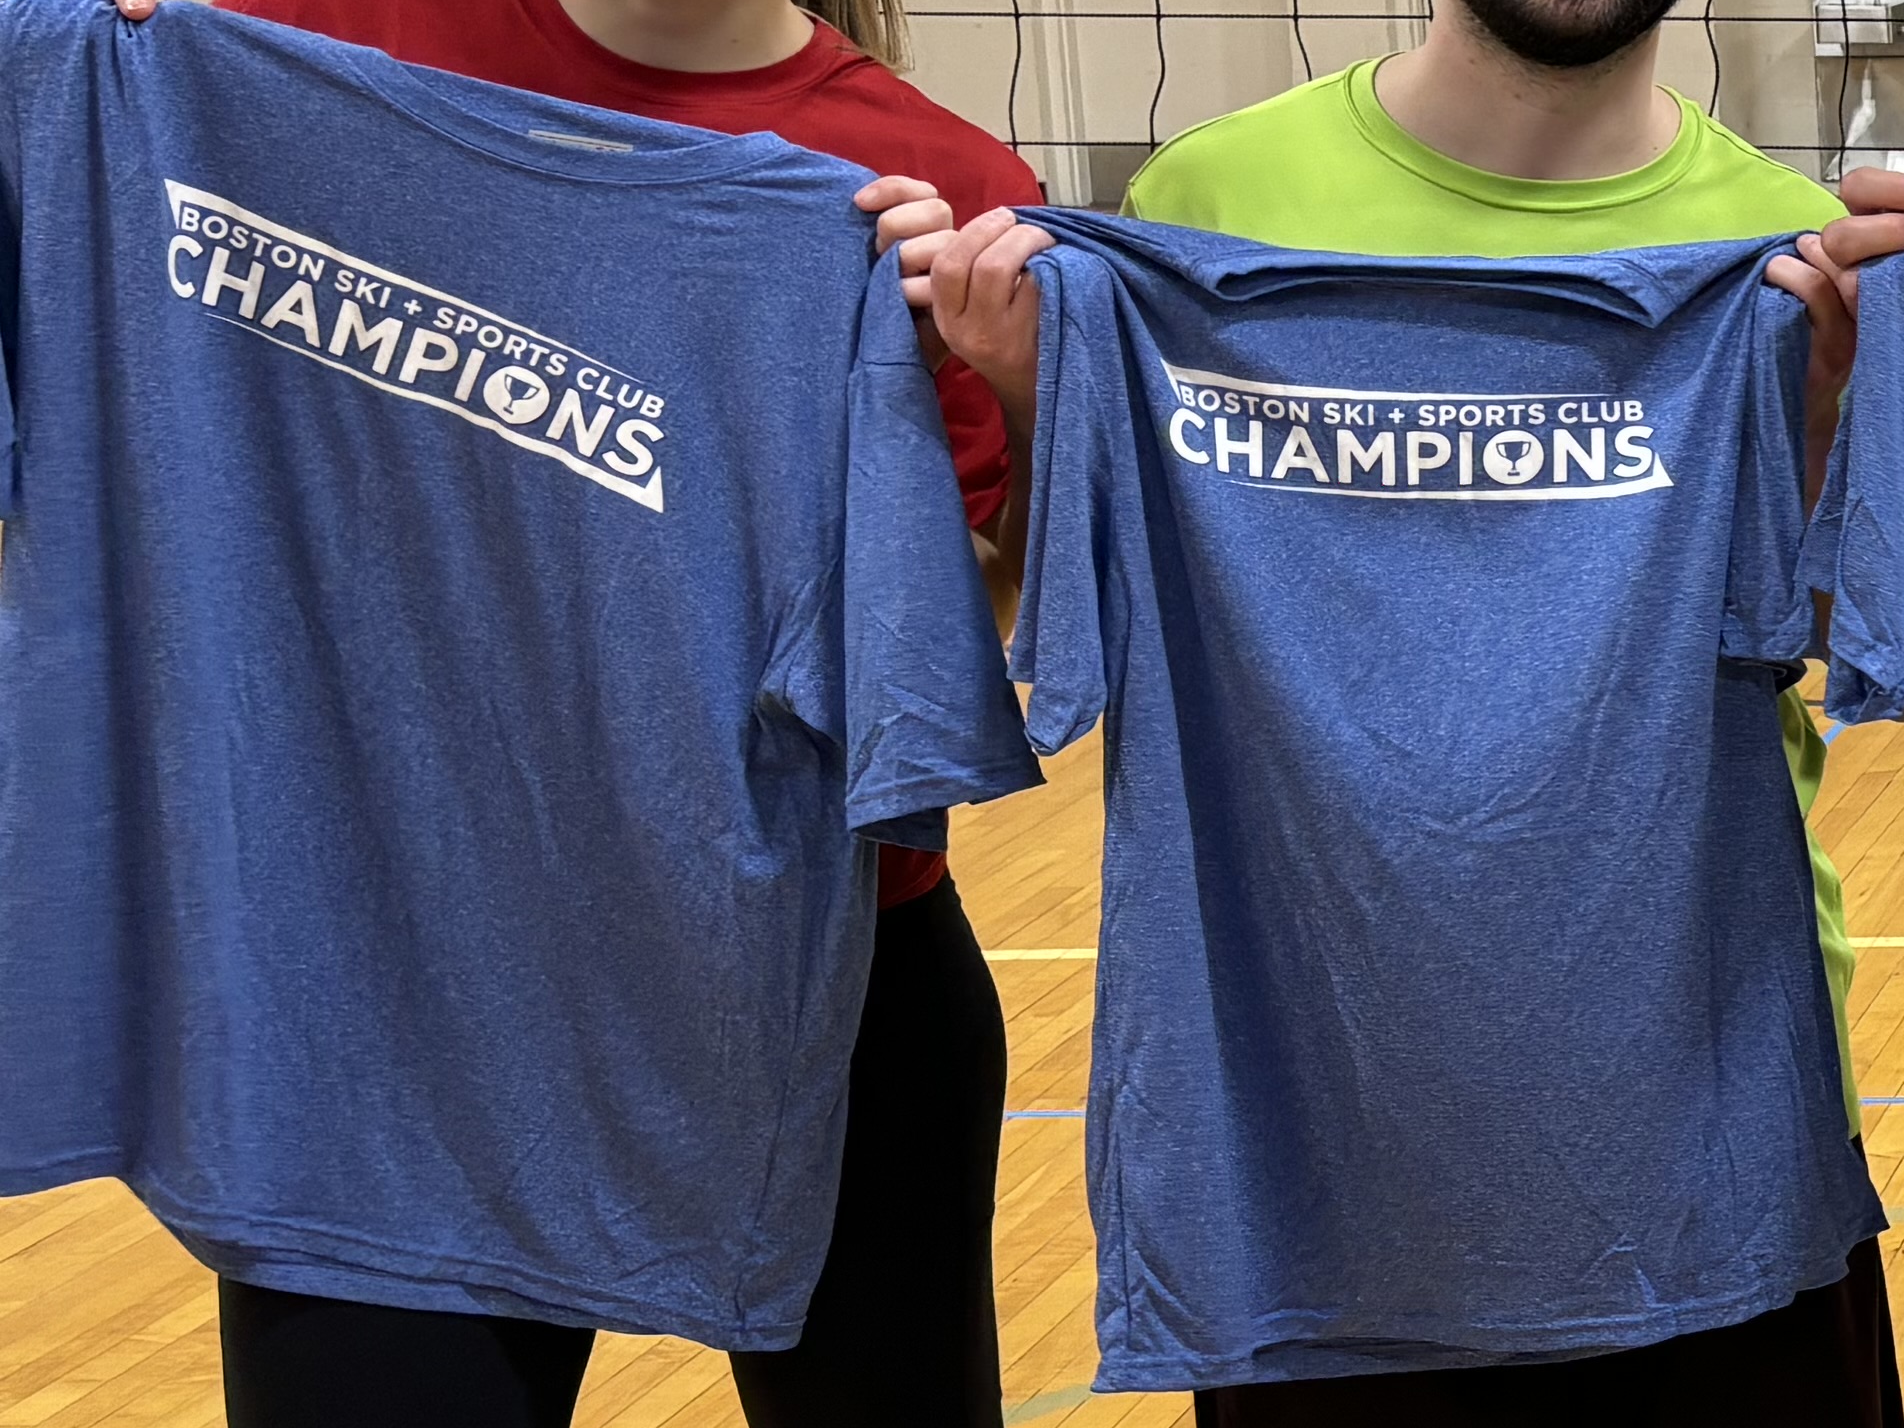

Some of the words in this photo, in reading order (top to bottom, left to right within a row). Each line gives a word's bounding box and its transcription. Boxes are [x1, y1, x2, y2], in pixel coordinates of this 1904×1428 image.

[167, 234, 665, 476] CHAMPIONS
[181, 206, 325, 282] BOSTON
[334, 270, 391, 308] SKI
[433, 307, 569, 376] SPORTS
[576, 366, 665, 419] CLUB
[1169, 408, 1655, 485] CHAMPIONS
[1182, 384, 1309, 424] BOSTON
[1324, 403, 1374, 426] SKI
[1418, 403, 1546, 426] SPORTS
[1557, 401, 1644, 424] CLUB
